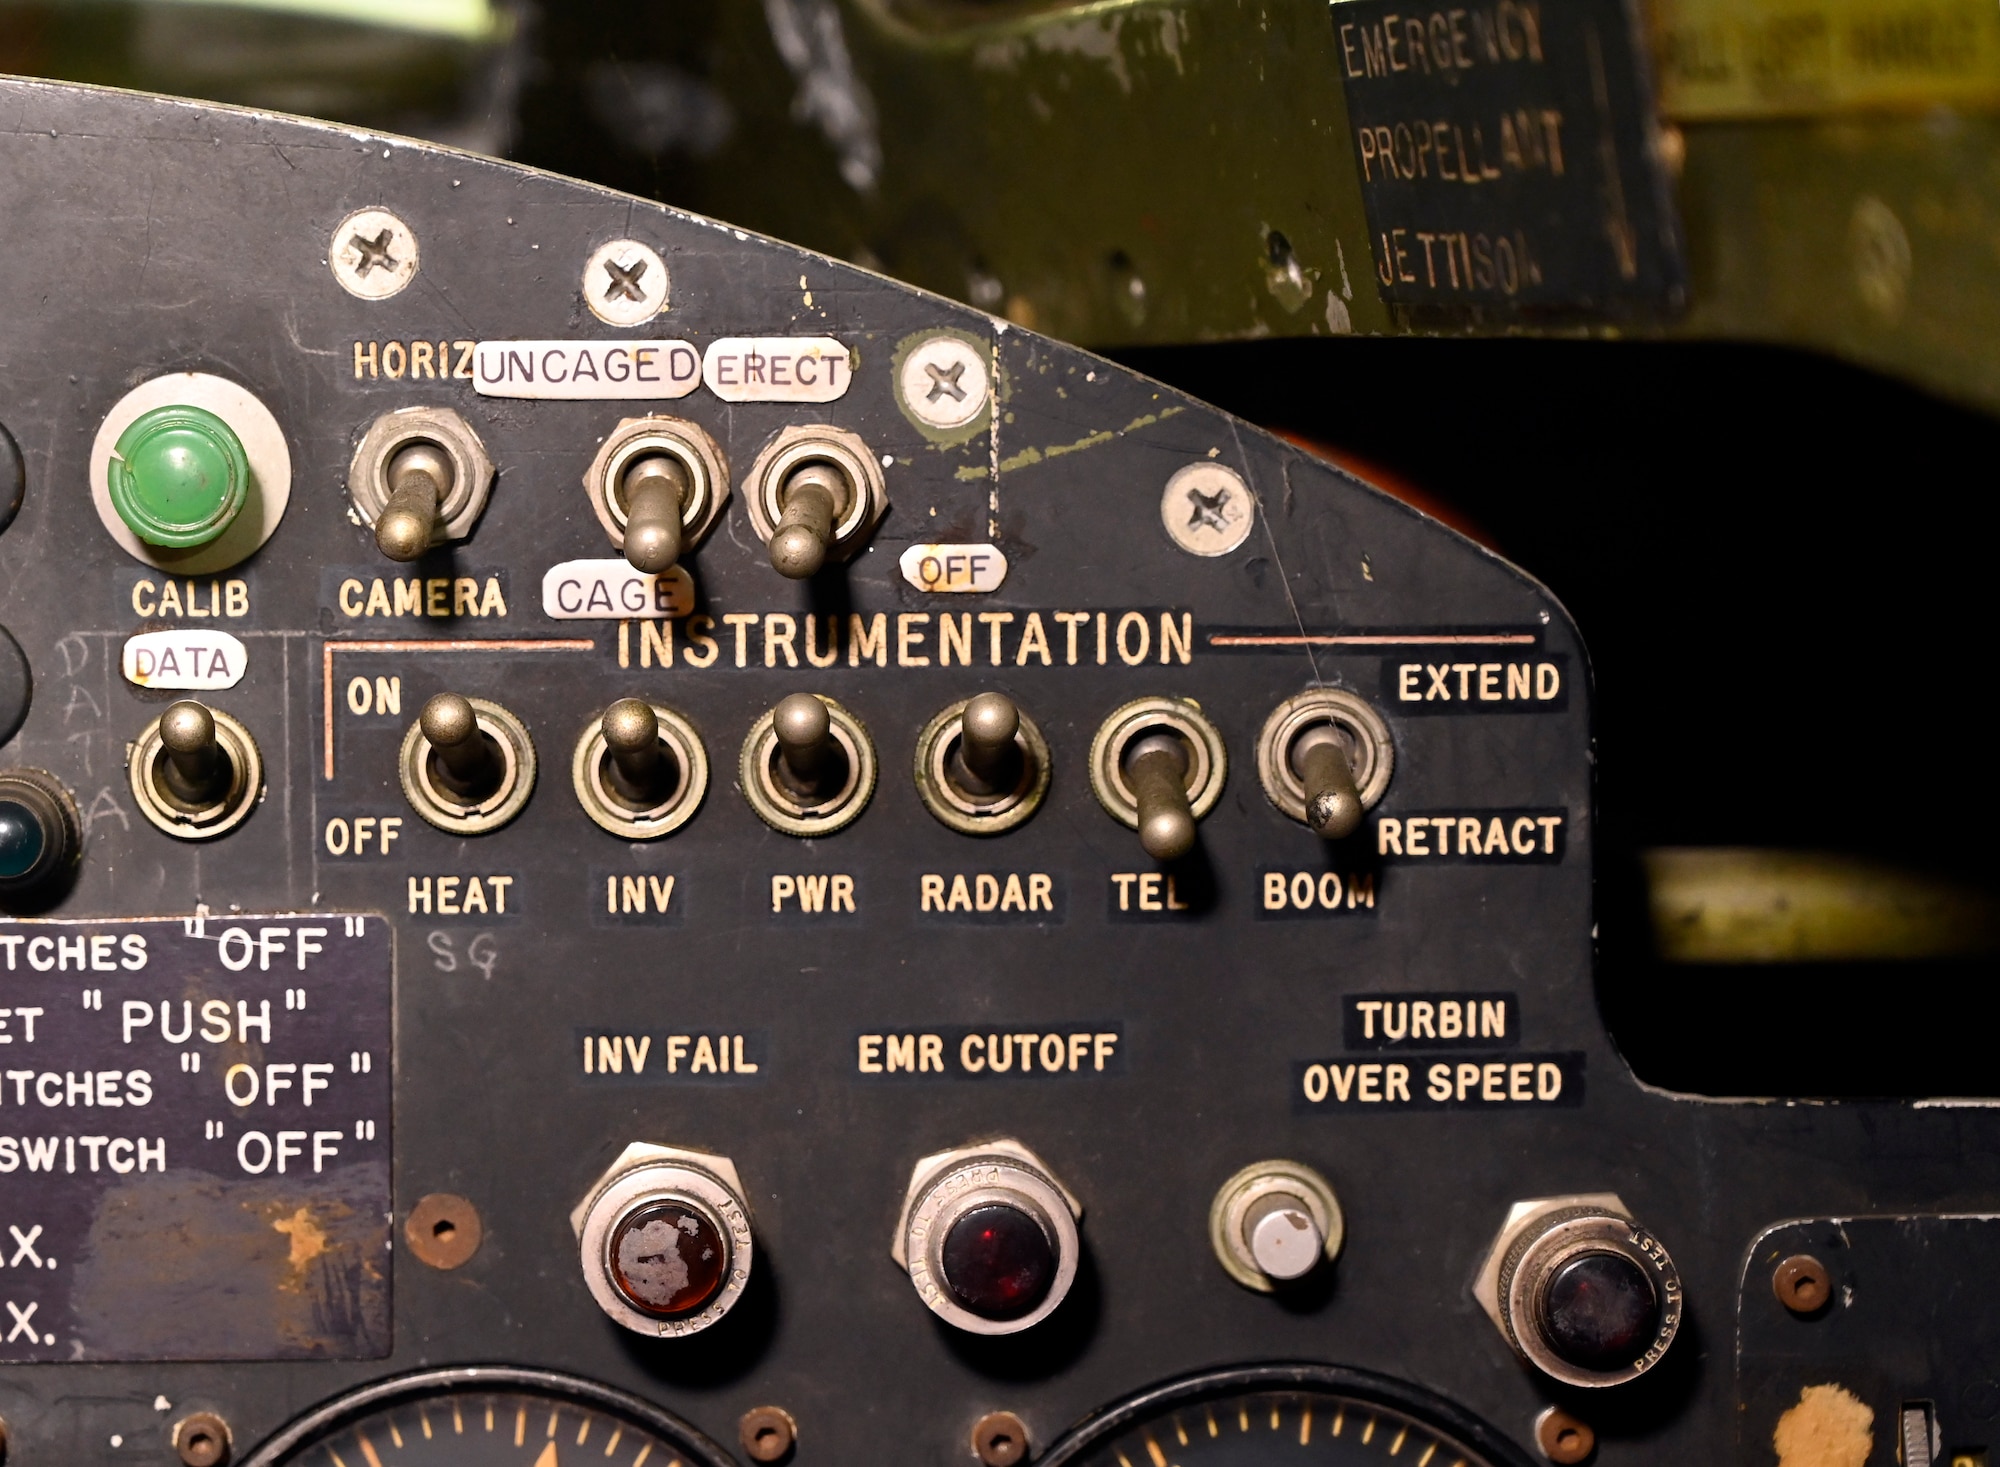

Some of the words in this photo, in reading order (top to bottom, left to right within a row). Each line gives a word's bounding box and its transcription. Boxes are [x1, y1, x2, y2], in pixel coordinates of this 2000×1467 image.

[1358, 108, 1565, 183] PROPELLANT
[480, 347, 696, 385] UNCAGED
[717, 354, 847, 387] ERECT
[918, 555, 991, 586] OFF
[132, 579, 249, 619] CALIB
[338, 577, 508, 619] CAMERA
[557, 577, 679, 613] CAGE
[617, 611, 1193, 669] INSTRUMENTATION
[135, 647, 231, 679] DATA
[1397, 662, 1561, 702] EXTEND
[347, 676, 402, 716] ON
[324, 817, 403, 856] OFF
[1378, 816, 1563, 857] RETRACT
[408, 875, 514, 915] HEAT
[606, 875, 676, 914] INV
[771, 873, 855, 913] PWR
[920, 873, 1053, 913] RADAR
[1111, 872, 1189, 911] TEL
[1263, 872, 1375, 910] BOOM
[1356, 1000, 1506, 1040] TURBIN
[583, 1035, 651, 1075] INV
[667, 1034, 758, 1075] FAIL
[858, 1033, 943, 1074] EMR
[960, 1032, 1118, 1073] CUTOFF
[0, 1070, 153, 1107] TCHES
[1303, 1064, 1410, 1103] OVER
[1427, 1062, 1563, 1102] SPEED
[0, 1136, 166, 1174] SWITCH
[933, 1167, 1000, 1208] PRESS
[718, 1199, 750, 1250] TEST
[0, 1225, 57, 1270] X.
[1629, 1231, 1669, 1271] TEST
[727, 1269, 747, 1293] TO
[1664, 1279, 1681, 1304] TO
[0, 1301, 55, 1346] X.
[657, 1301, 726, 1336] PRESS
[1633, 1314, 1678, 1373] PRESS
